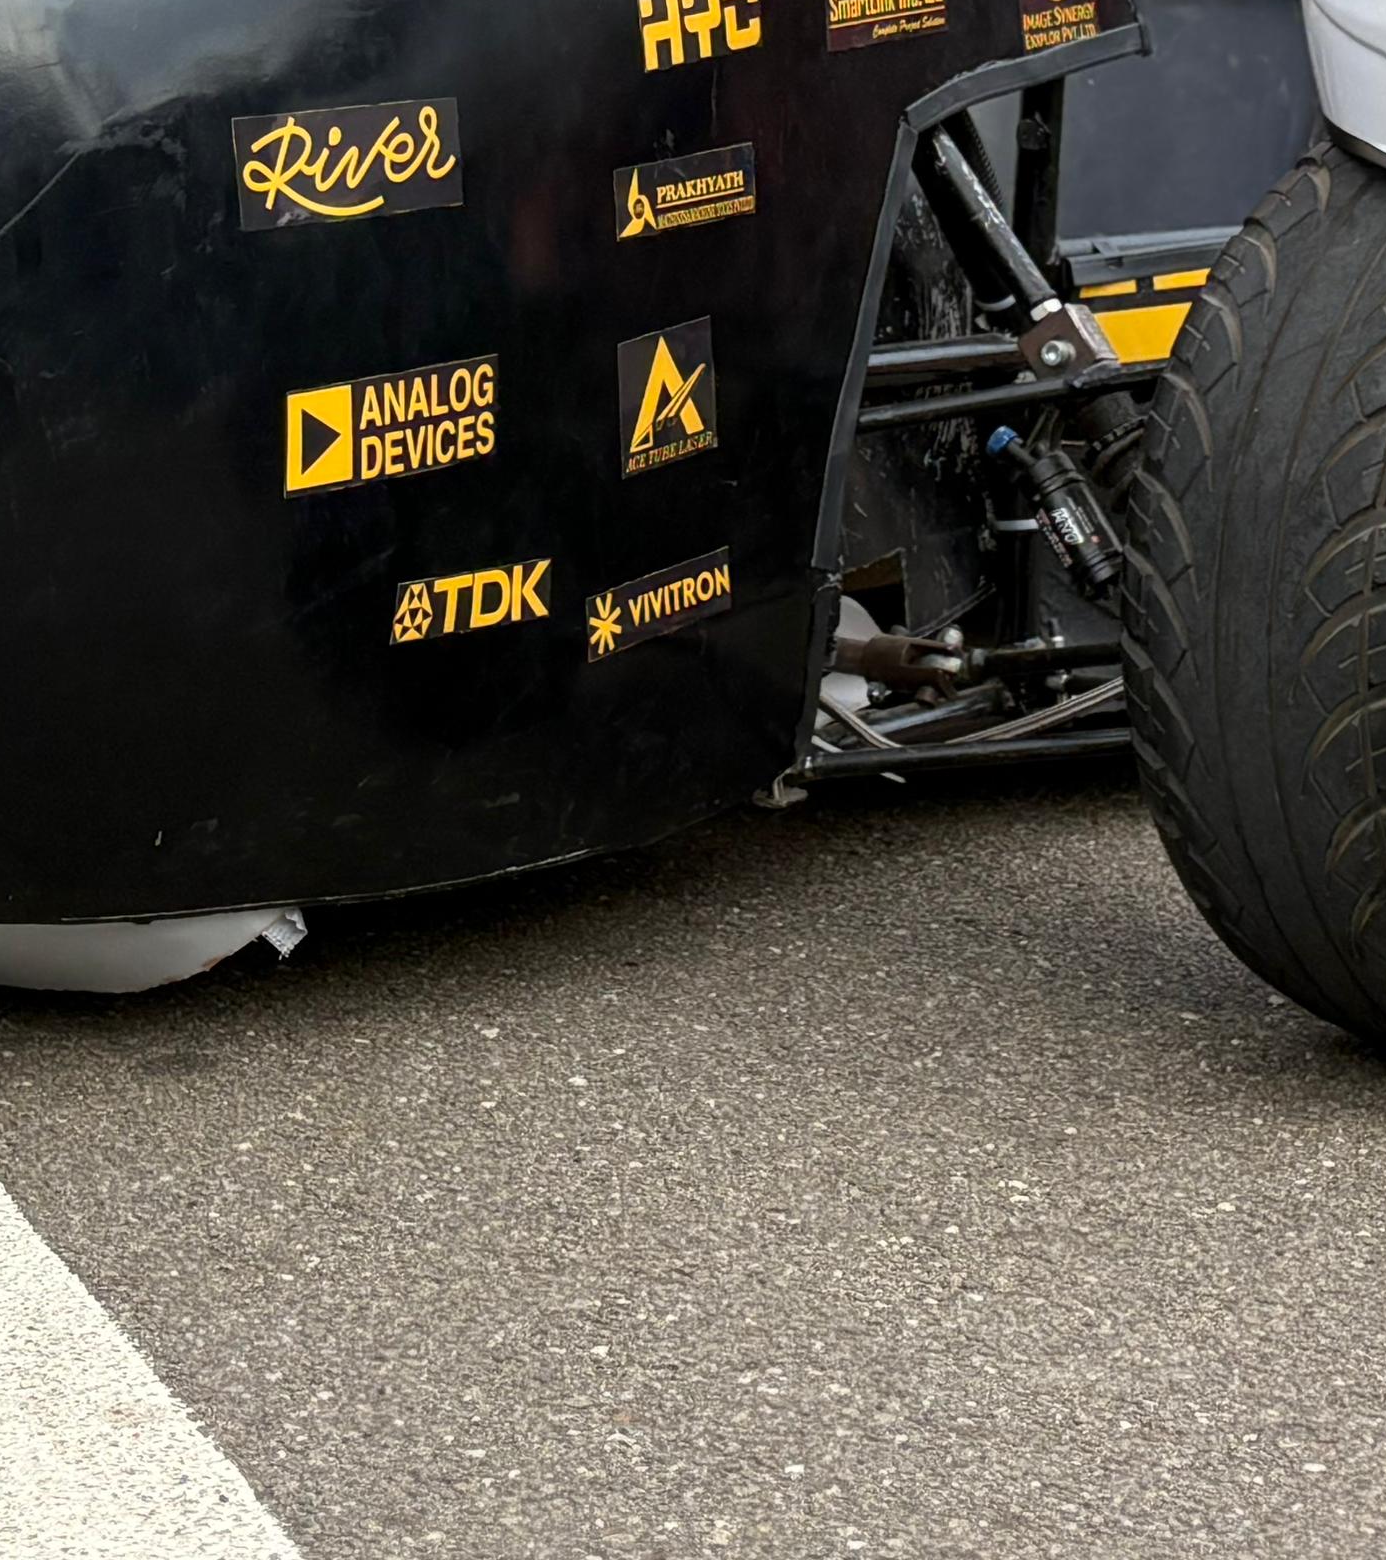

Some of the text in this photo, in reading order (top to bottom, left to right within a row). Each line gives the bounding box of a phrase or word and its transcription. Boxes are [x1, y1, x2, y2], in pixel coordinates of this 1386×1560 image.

[1053, 2, 1095, 26] SYNERGY
[242, 105, 457, 217] River
[656, 169, 744, 204] PRAKHYATH
[359, 363, 494, 431] ANALOG
[360, 410, 495, 480] DEVICES
[626, 431, 714, 473] ACE TUBE LASER
[433, 559, 553, 634] TDK
[627, 563, 731, 628] VIVITRON
